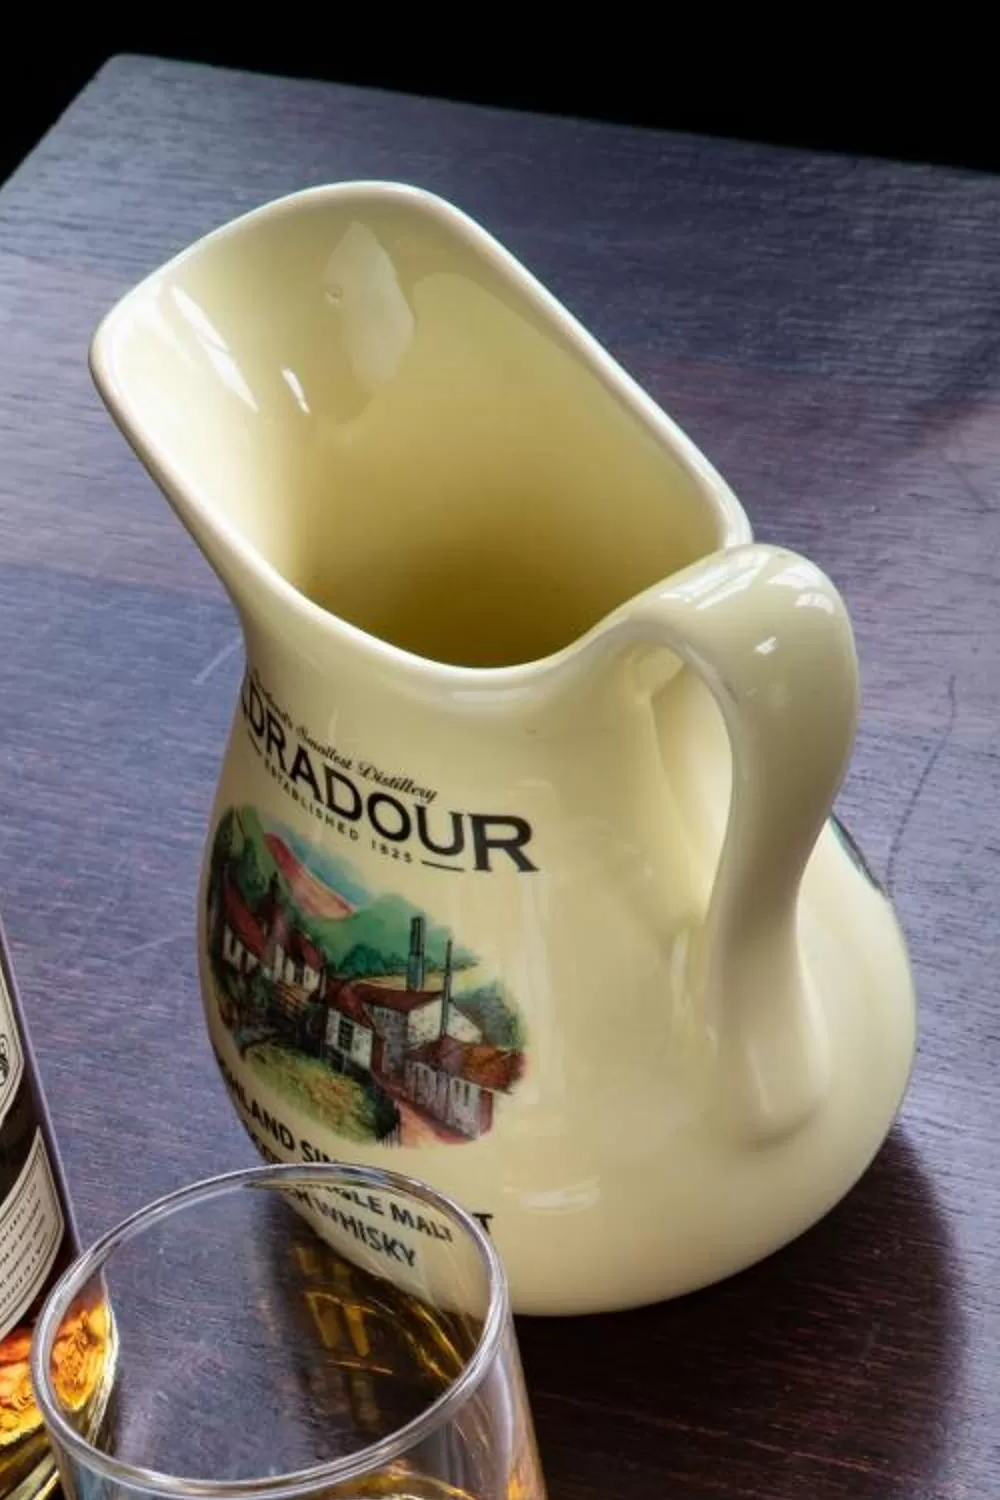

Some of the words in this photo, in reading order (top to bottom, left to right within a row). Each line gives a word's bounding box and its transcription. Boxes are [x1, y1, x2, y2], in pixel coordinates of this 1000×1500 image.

[241, 678, 540, 873] DRADOUR
[296, 724, 353, 771] Smallest
[357, 758, 439, 803] Distillery
[264, 756, 360, 842] ESTABLISHED
[371, 840, 413, 864] 1825
[316, 1199, 417, 1268] WHISKY
[390, 1202, 455, 1244] MALT
